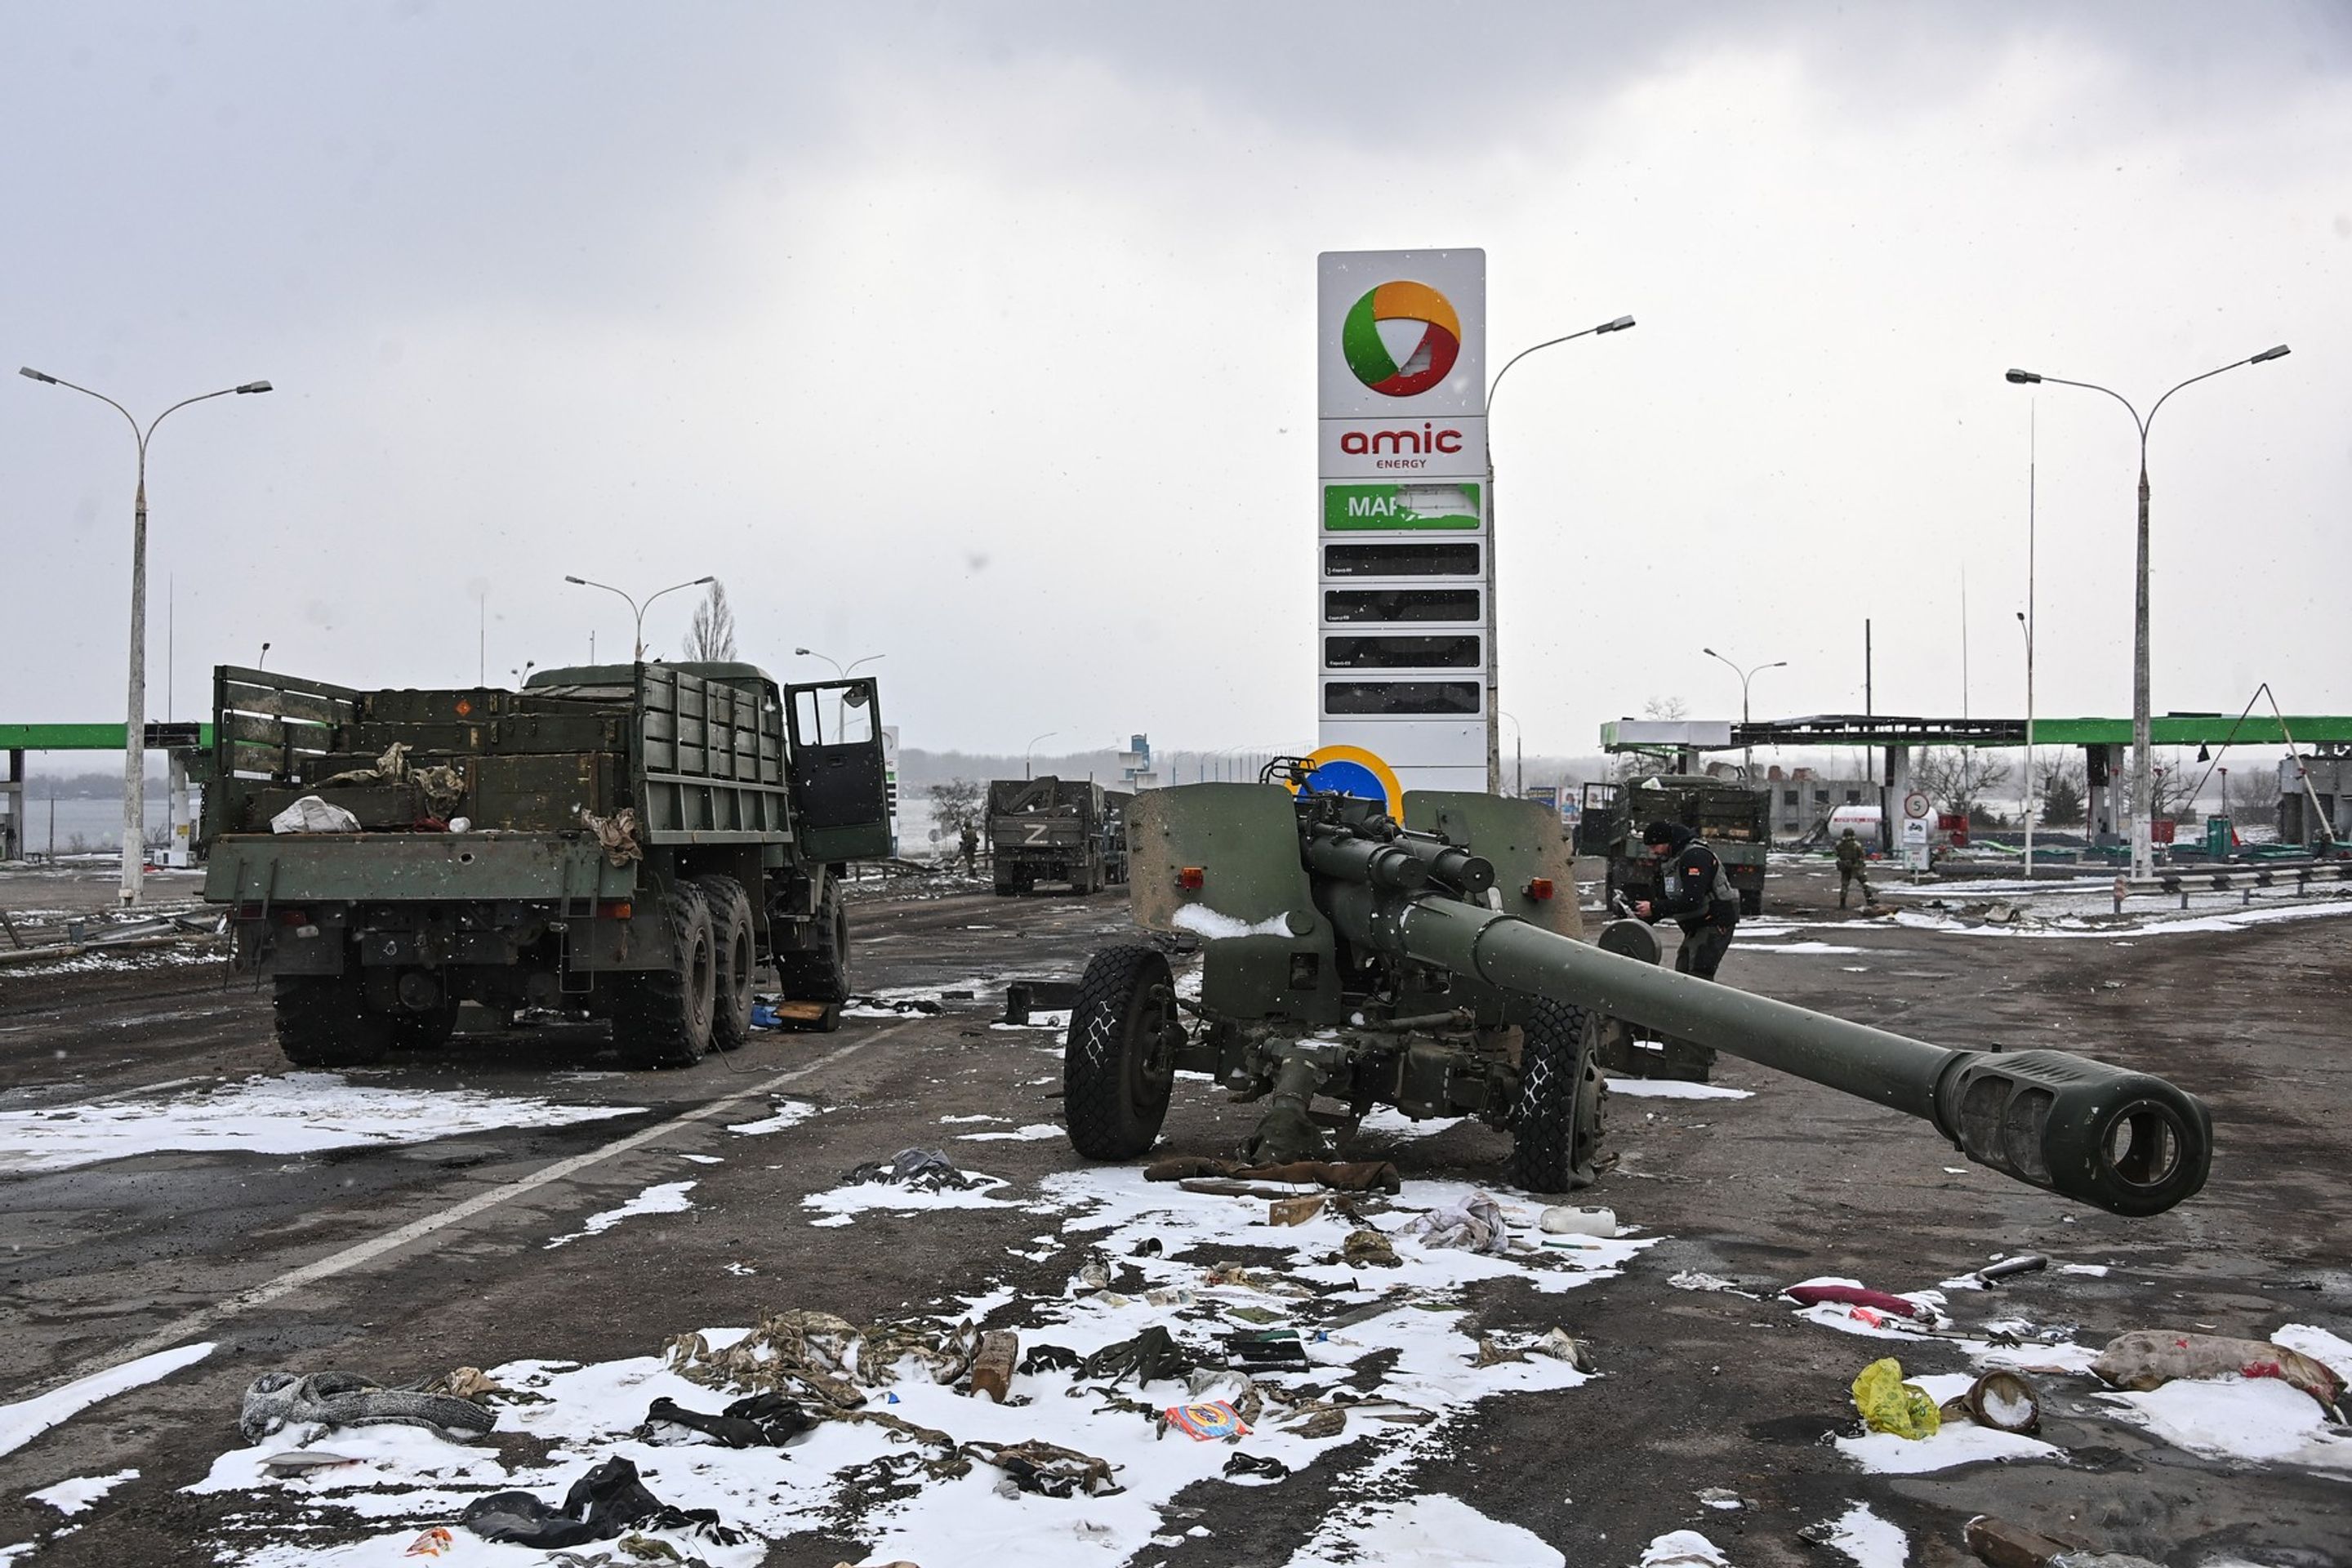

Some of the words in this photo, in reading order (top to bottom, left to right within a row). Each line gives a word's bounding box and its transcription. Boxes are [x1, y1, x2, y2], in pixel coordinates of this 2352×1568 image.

[1340, 422, 1463, 454] amic
[1376, 459, 1427, 469] ENERGY
[1913, 800, 1921, 811] 5
[1024, 823, 1049, 844] Z
